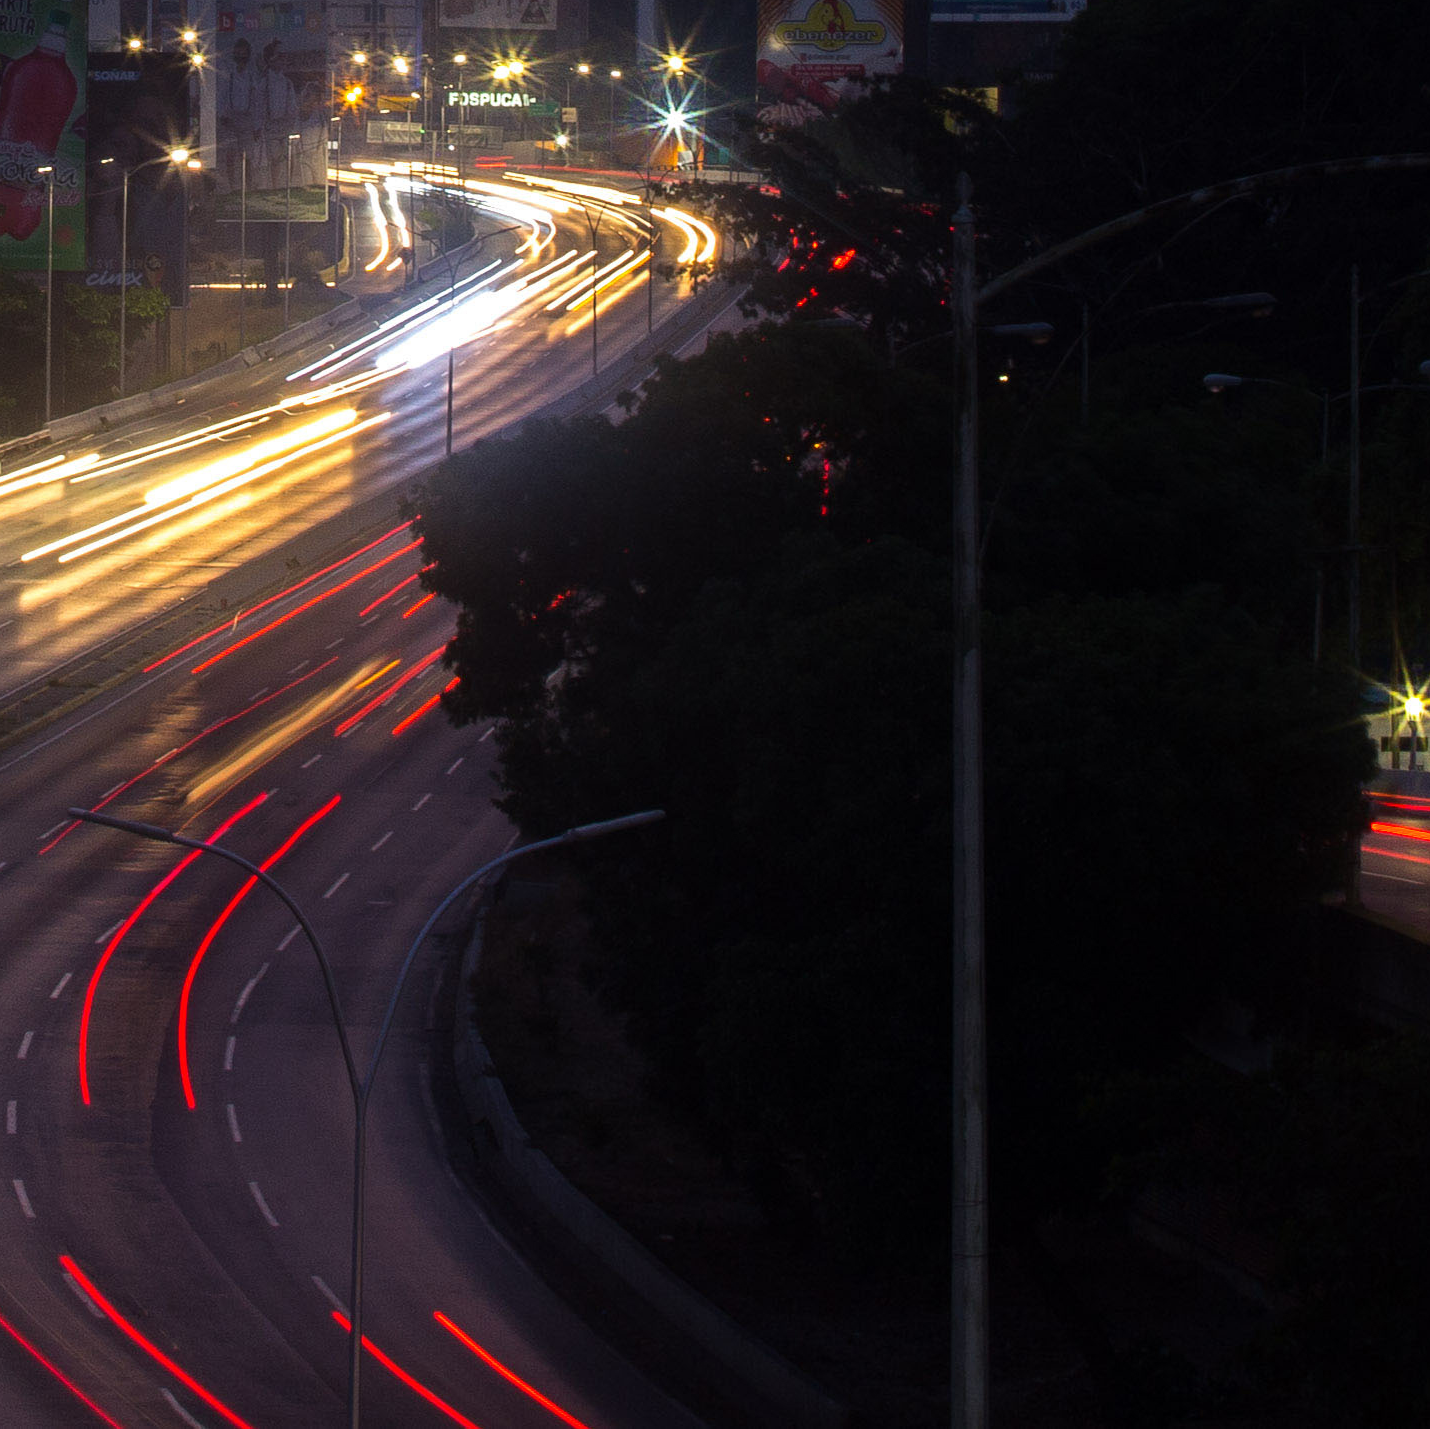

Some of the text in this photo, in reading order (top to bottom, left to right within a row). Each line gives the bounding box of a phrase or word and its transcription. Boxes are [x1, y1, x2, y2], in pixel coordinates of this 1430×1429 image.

[784, 28, 876, 41] ebenezer
[449, 92, 522, 107] FOSPUCA
[85, 271, 143, 286] cinex
